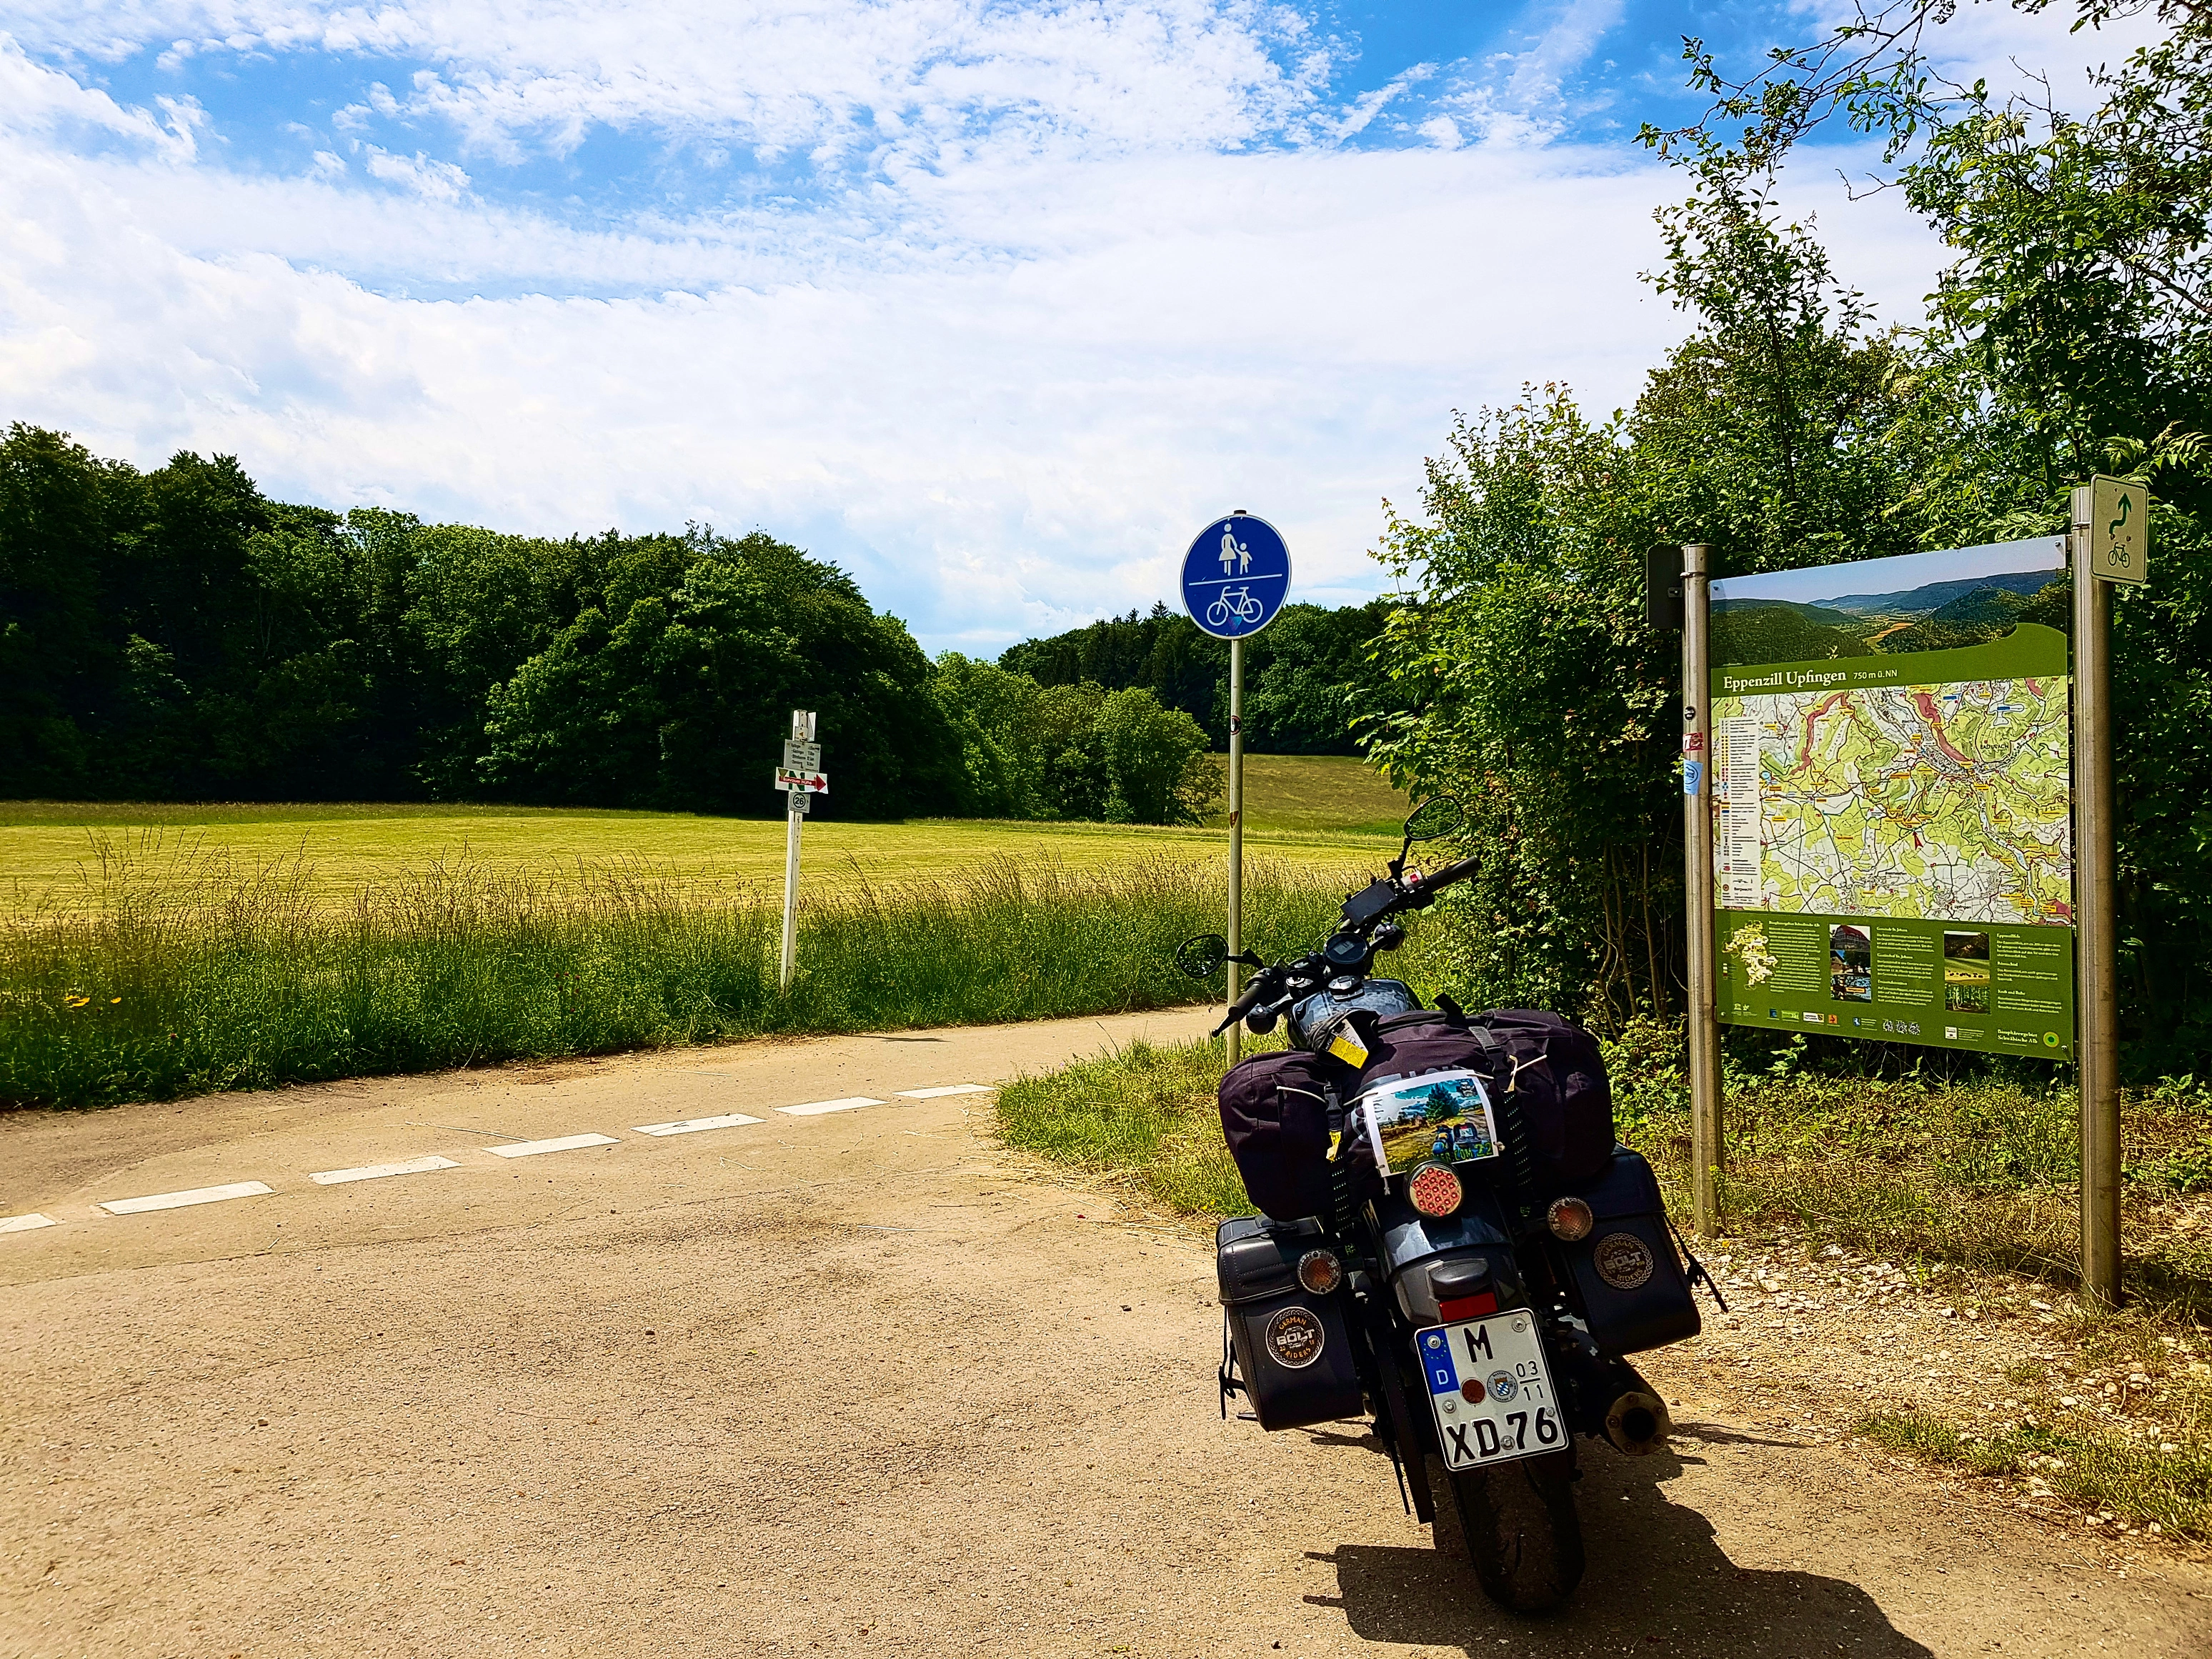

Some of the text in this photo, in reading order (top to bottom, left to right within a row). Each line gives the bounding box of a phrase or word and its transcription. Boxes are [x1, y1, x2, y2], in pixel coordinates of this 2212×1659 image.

[1723, 671, 1783, 692] Eppenzill
[1786, 669, 1847, 688] Upfingen
[794, 797, 804, 805] 26
[1603, 1252, 1641, 1270] BOLT
[1617, 1268, 1643, 1281] RIDERS
[1278, 1316, 1307, 1330] GERMAN
[1276, 1329, 1315, 1346] BOLT
[1463, 1324, 1493, 1363] M
[1285, 1347, 1311, 1358] RIDERS
[1515, 1360, 1538, 1377] 03
[1436, 1370, 1449, 1385] D
[1523, 1384, 1544, 1401] 11
